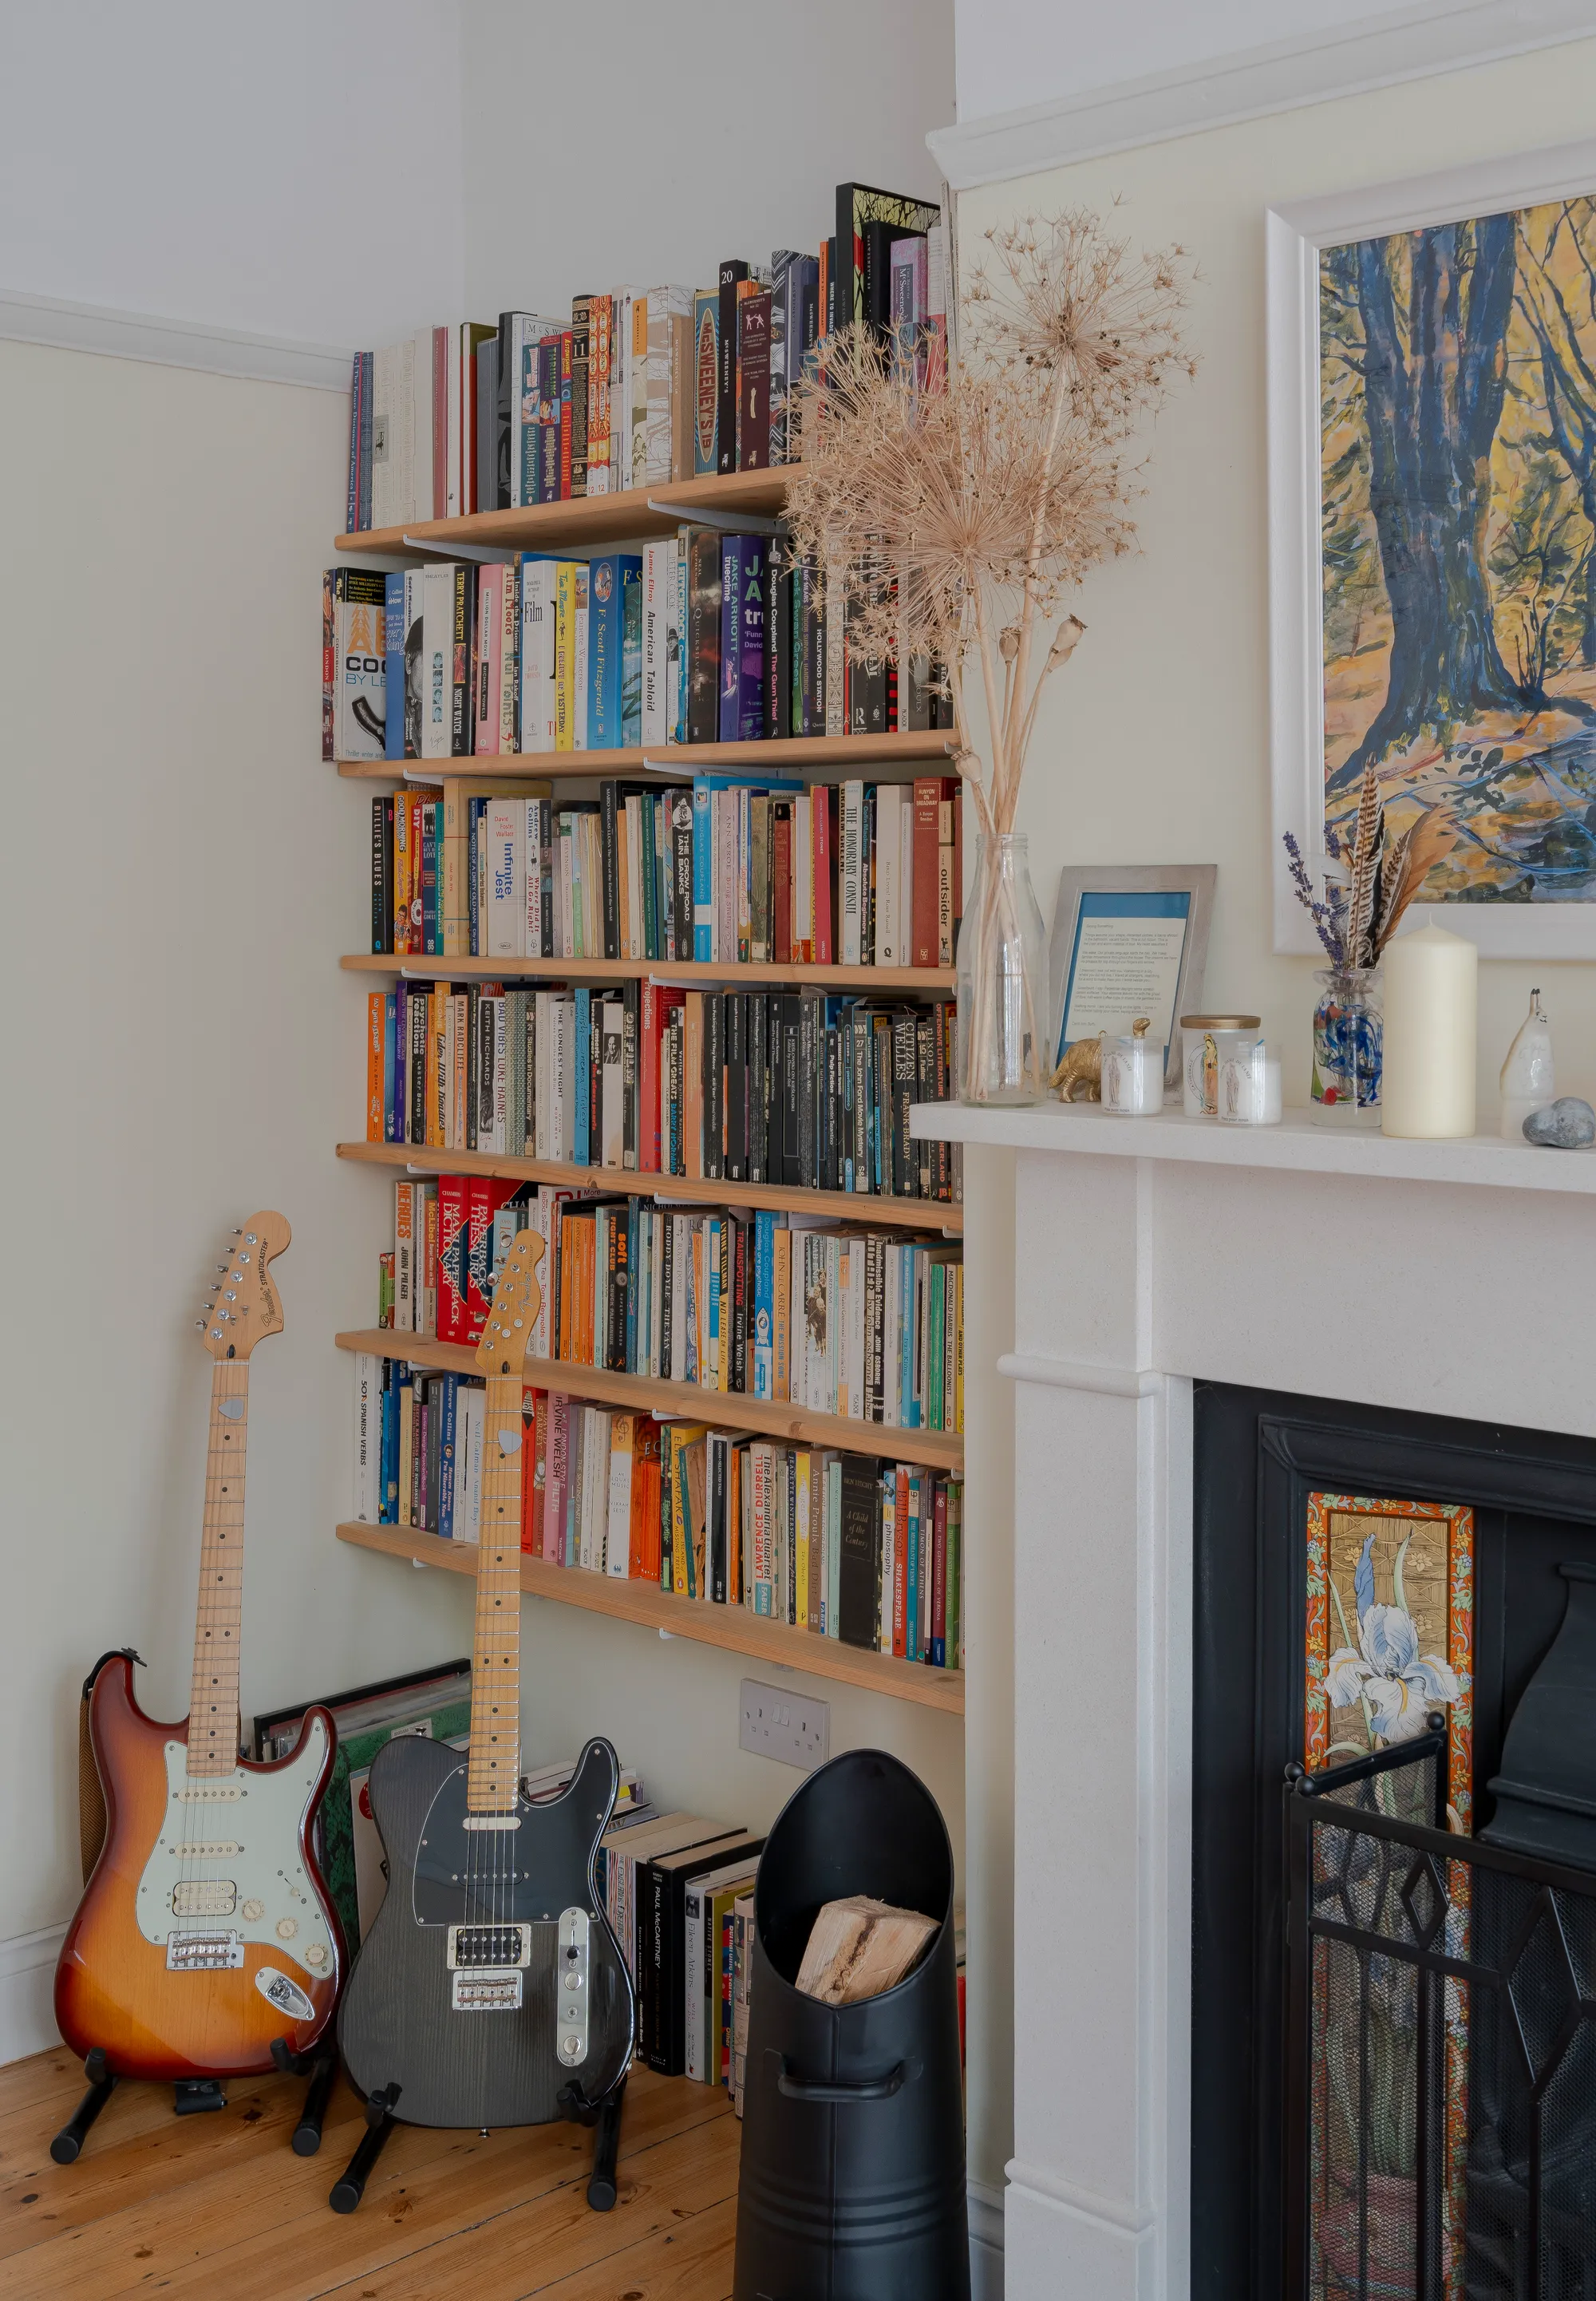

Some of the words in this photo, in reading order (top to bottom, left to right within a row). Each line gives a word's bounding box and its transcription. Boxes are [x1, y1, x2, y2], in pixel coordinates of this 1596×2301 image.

[721, 271, 733, 284] 20
[573, 345, 585, 357] 11
[699, 322, 713, 429] McSWEENEY'S
[350, 451, 356, 460] of
[701, 433, 712, 448] 19
[598, 608, 606, 619] F.
[597, 623, 606, 653] Scott
[594, 658, 606, 716] Fitzgerald
[646, 670, 655, 711] Tabloid
[846, 806, 857, 824] THE
[504, 843, 513, 895] Infinite
[845, 829, 857, 876] HONORARY
[496, 870, 504, 900] Jest
[527, 892, 534, 902] Go
[845, 880, 856, 915] CONSUL
[940, 868, 950, 927] outsider
[643, 981, 653, 1030] Projections
[895, 1022, 906, 1081] WELLES
[905, 1022, 915, 1081] CITIZEN
[397, 1184, 412, 1239] HEROES
[258, 1240, 269, 1286] STRATOCASTER
[443, 1202, 452, 1288] DICTIONARY
[469, 1205, 480, 1288] THESAURUS
[478, 1205, 488, 1288] PAPERBACK
[618, 1232, 626, 1263] soft
[260, 1288, 282, 1326] Fender
[451, 1247, 460, 1325] PAPERBACK
[518, 1271, 534, 1314] Fender
[554, 1396, 563, 1433] IRVINE
[763, 1477, 772, 1536] Alexandria
[896, 1490, 907, 1512] Bill
[755, 1513, 764, 1579] LAWRENCE
[895, 1513, 906, 1557] Bryson
[762, 1537, 772, 1580] Quartet
